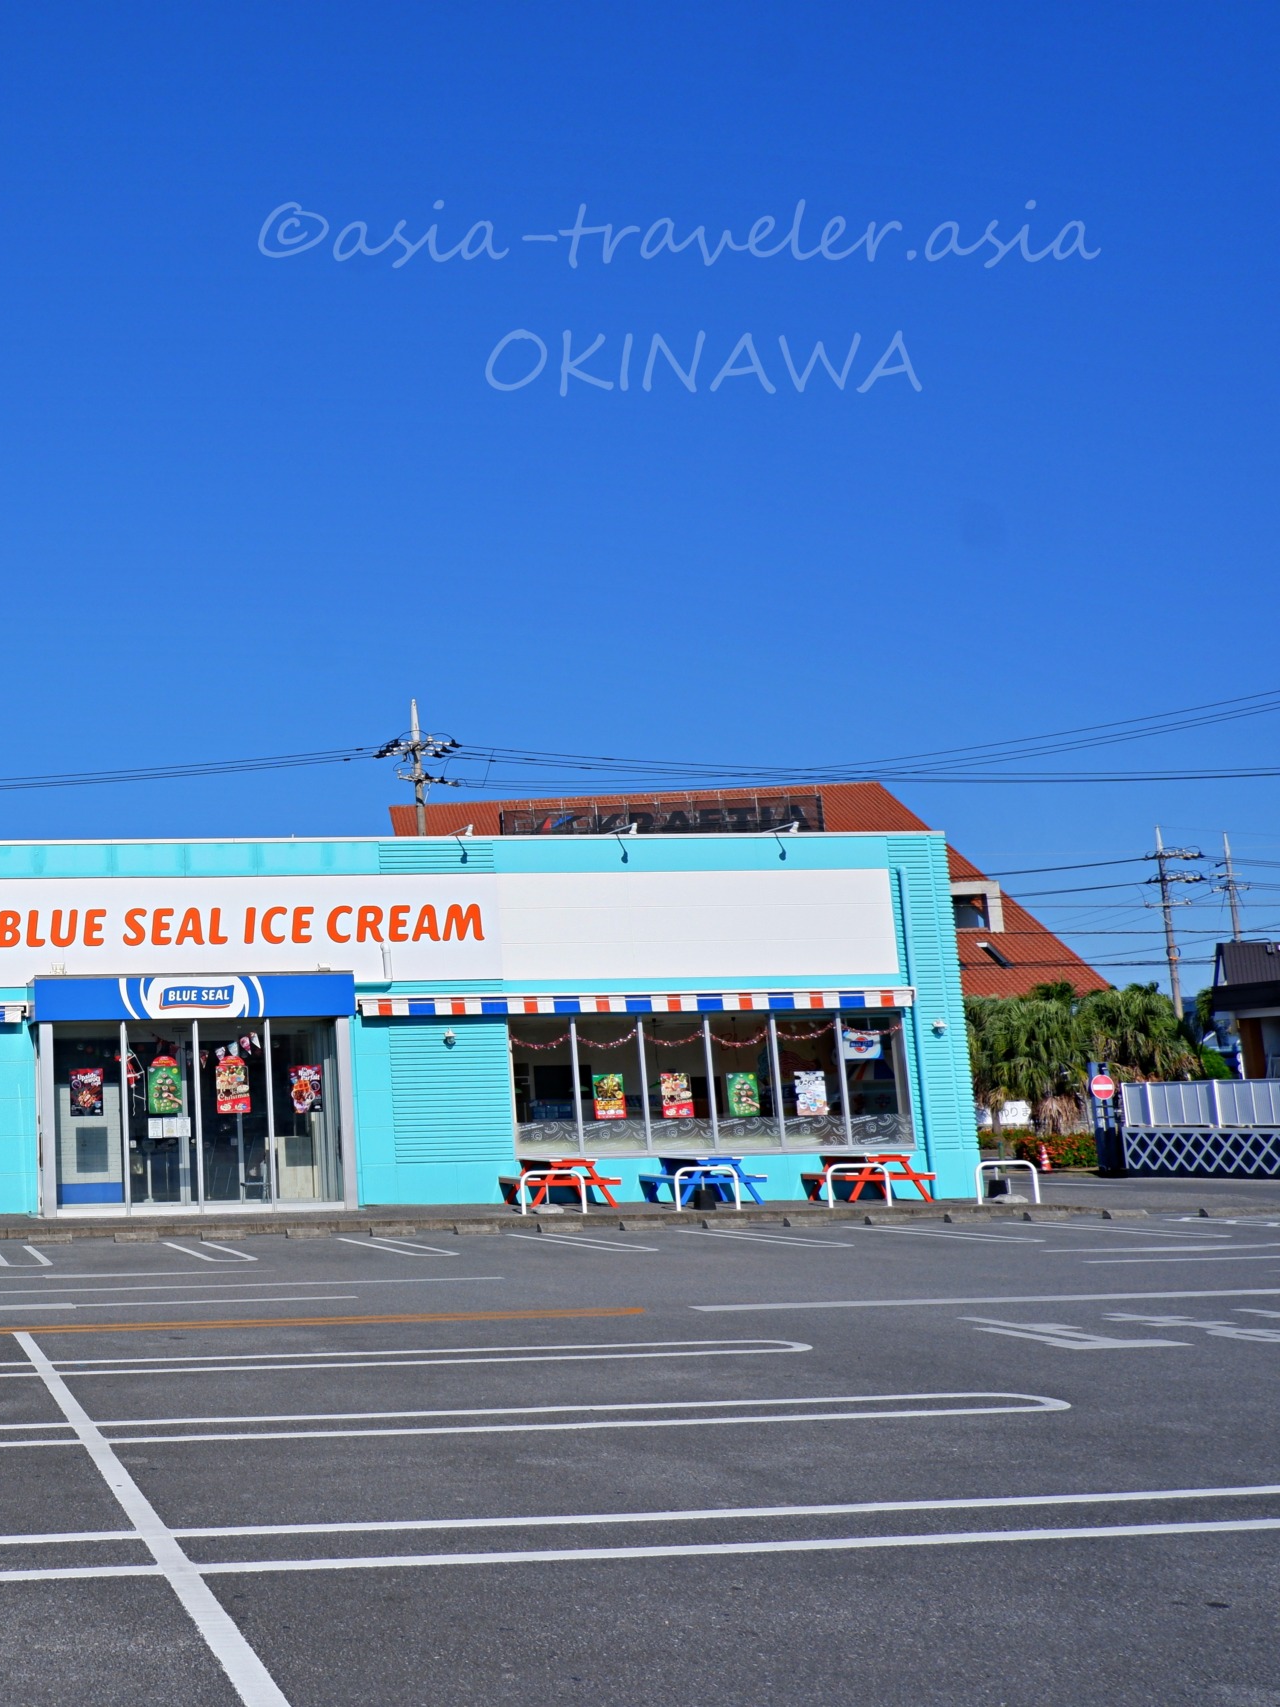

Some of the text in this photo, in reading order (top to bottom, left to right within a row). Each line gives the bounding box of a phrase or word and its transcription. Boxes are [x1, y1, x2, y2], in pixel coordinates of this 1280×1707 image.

[123, 907, 228, 946] SEAL
[244, 906, 314, 944] ICE
[326, 903, 485, 943] CREAM
[168, 989, 230, 1002] BLUE SEAL
